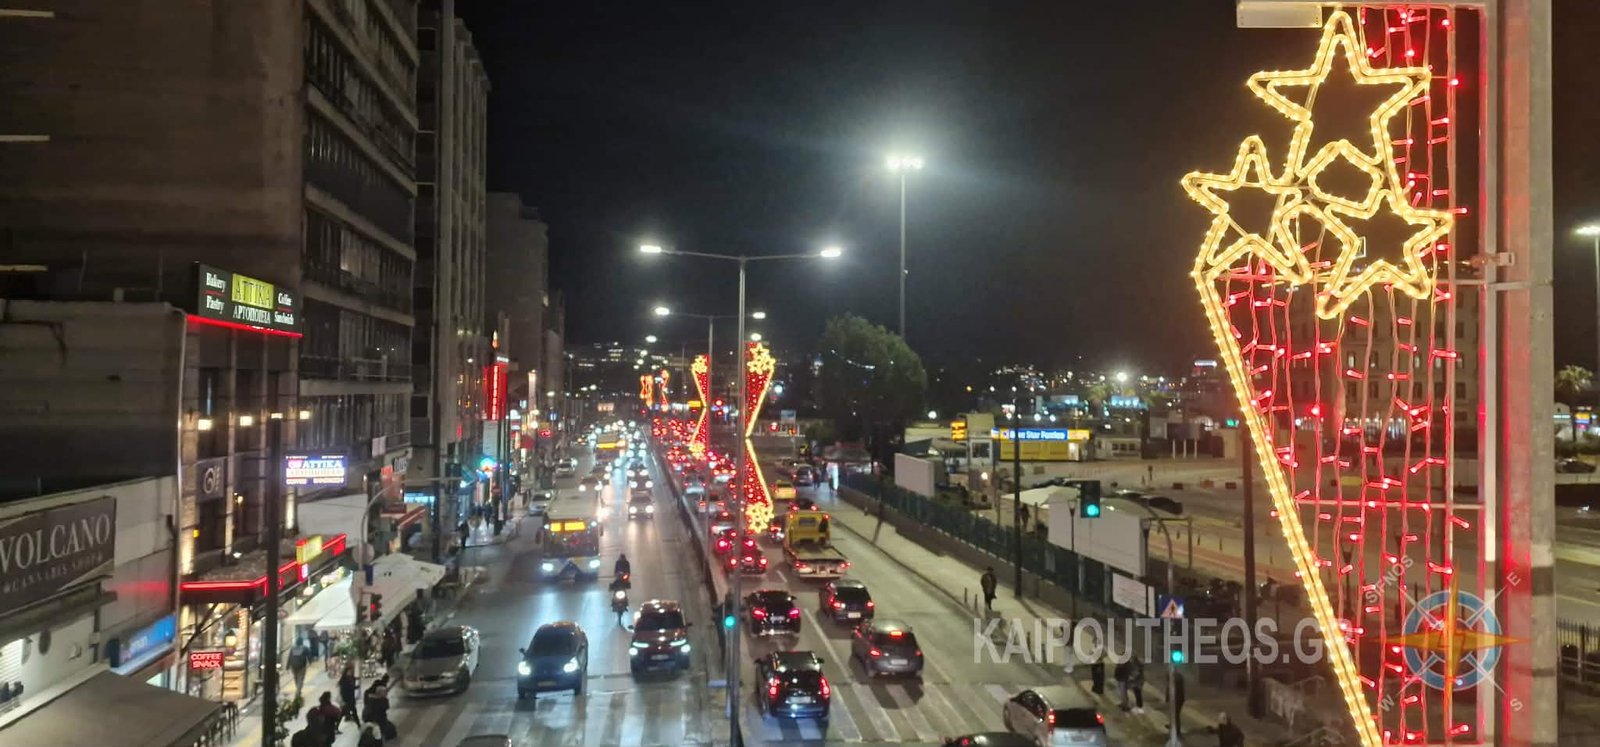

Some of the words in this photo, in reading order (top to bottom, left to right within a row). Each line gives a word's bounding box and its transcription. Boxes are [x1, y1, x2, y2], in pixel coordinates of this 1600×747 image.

[206, 272, 226, 293] Bakery
[206, 295, 225, 315] Pastry
[278, 292, 292, 306] Coffee
[1026, 430, 1040, 439] Star
[0, 514, 110, 574] VOLCANO
[193, 660, 220, 668] SNACK
